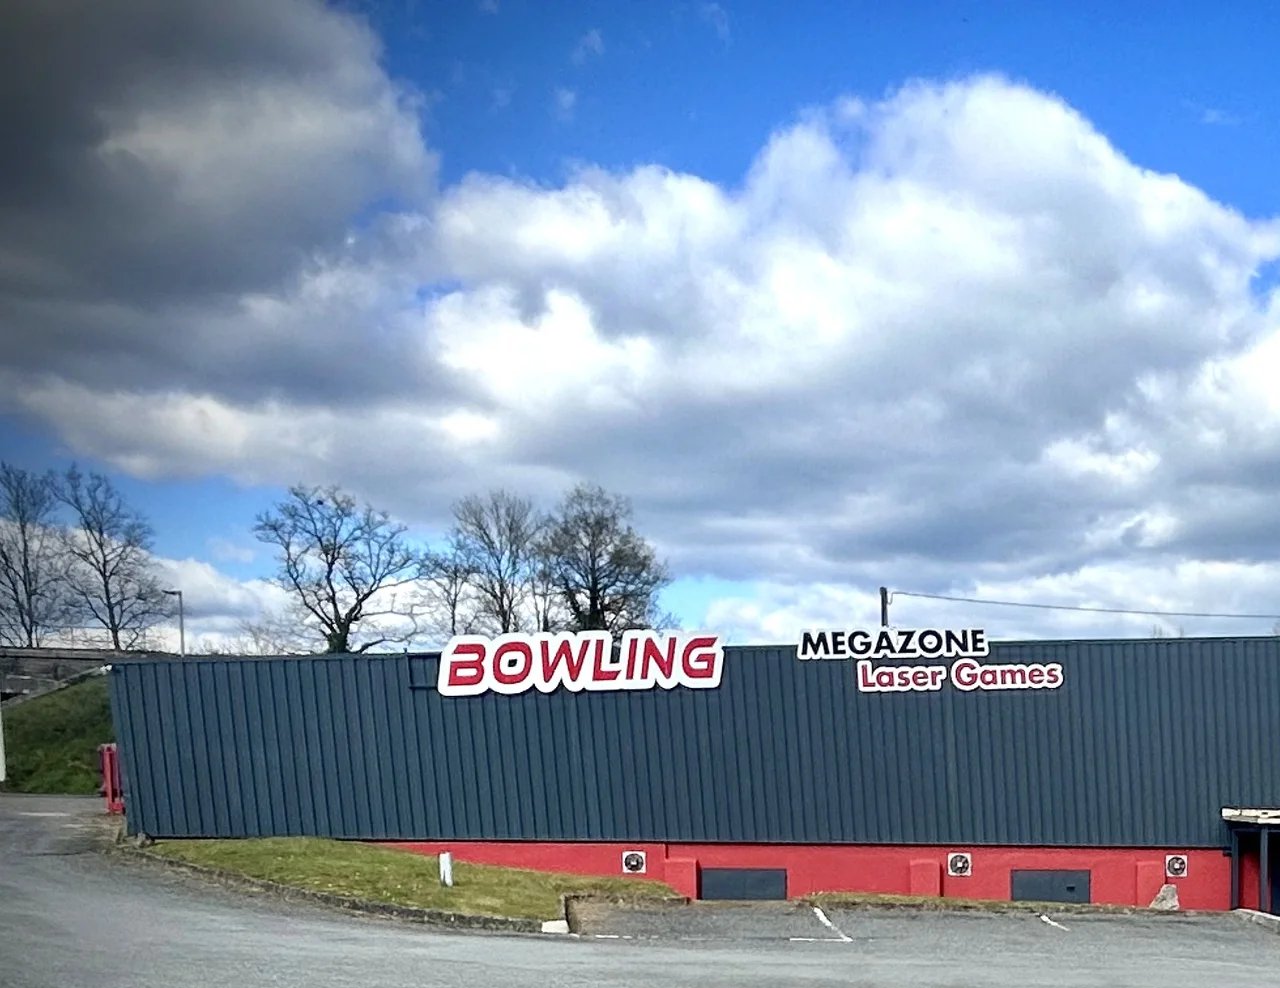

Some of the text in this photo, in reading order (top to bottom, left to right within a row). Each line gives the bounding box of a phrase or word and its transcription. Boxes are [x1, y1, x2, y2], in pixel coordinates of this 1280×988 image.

[801, 629, 985, 655] MEGAZONE
[447, 637, 718, 686] BOWLING
[861, 662, 1059, 687] Laser Games
